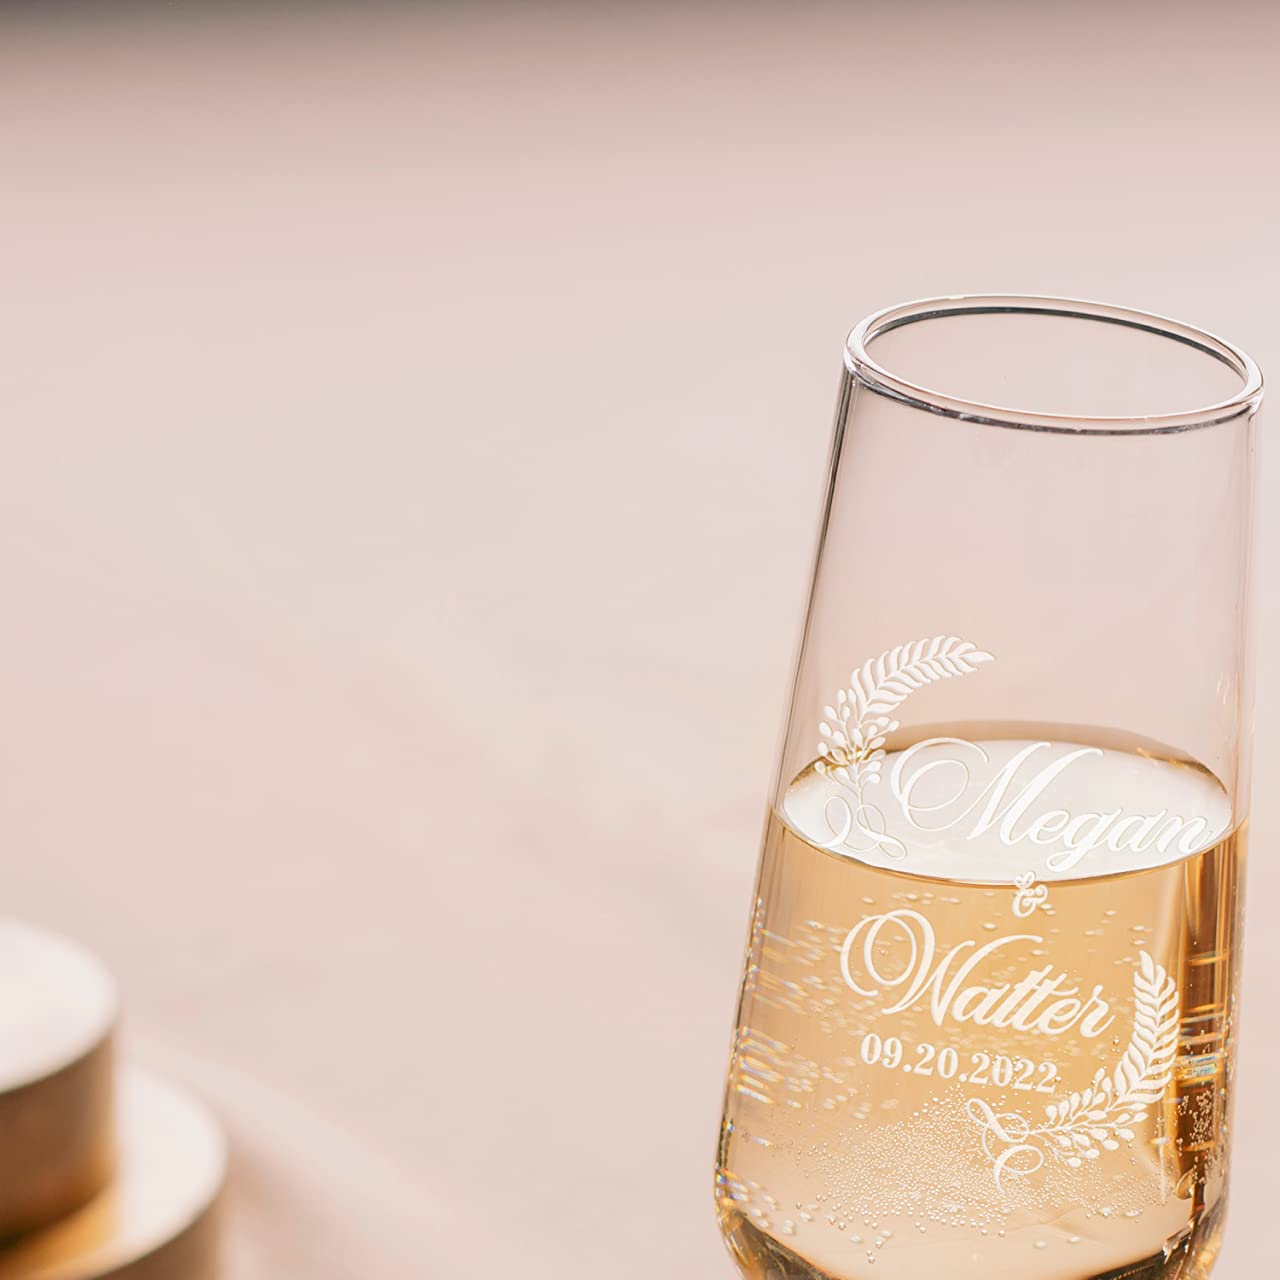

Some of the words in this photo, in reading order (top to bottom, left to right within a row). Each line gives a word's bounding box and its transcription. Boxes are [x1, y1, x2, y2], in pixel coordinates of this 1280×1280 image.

[892, 738, 1211, 872] Megan
[1012, 871, 1048, 917] &
[840, 909, 1115, 1037] Watter
[861, 1033, 1058, 1094] 09.20.2022
